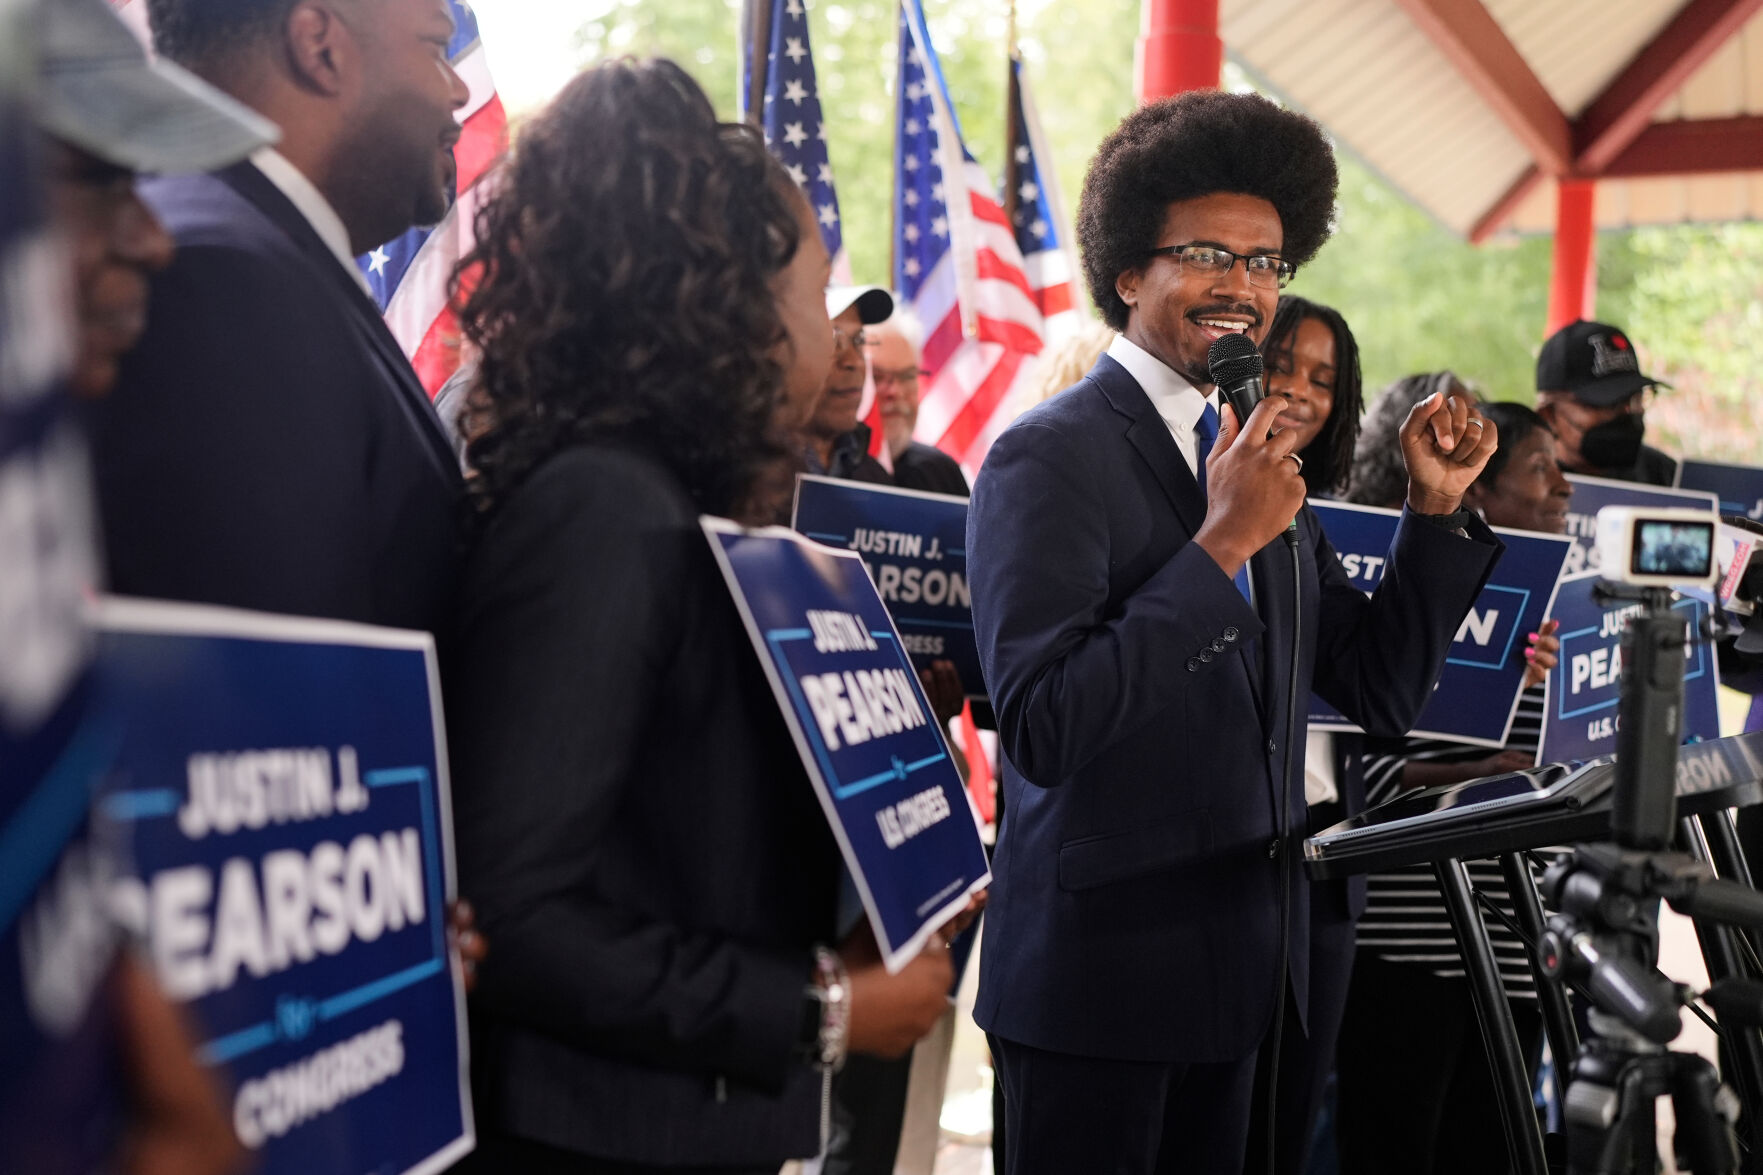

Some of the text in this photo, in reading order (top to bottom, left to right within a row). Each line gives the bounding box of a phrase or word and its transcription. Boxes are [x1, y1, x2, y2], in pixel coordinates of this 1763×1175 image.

[848, 527, 943, 561] JUSTIN J.
[864, 563, 971, 608] RSON
[806, 609, 867, 654] JUSTIN
[902, 634, 945, 655] RESS
[801, 668, 927, 752] PEARSON
[1588, 716, 1614, 742] U.S.
[179, 747, 333, 839] JUSTIN
[896, 784, 951, 839] CONGRESS
